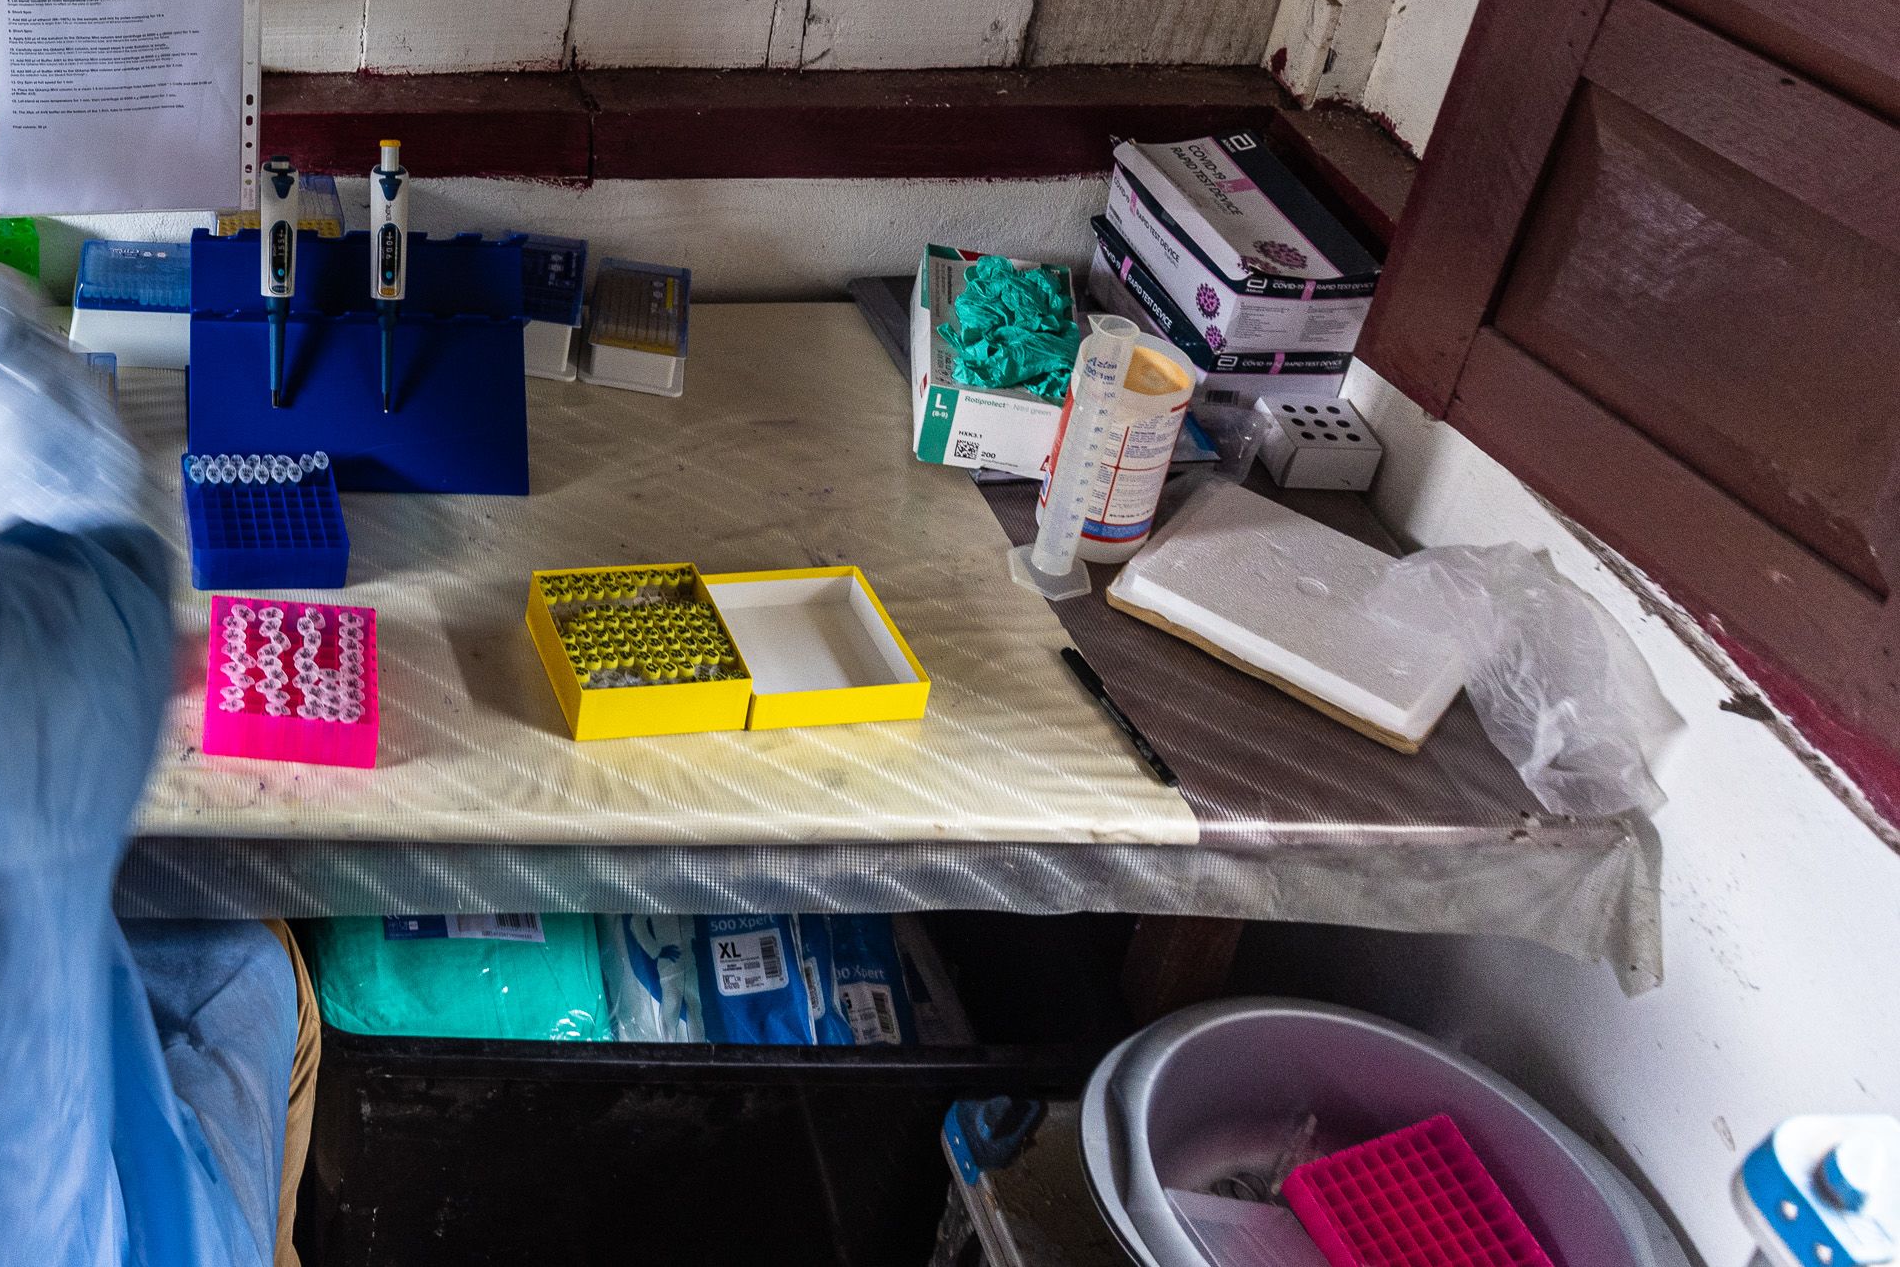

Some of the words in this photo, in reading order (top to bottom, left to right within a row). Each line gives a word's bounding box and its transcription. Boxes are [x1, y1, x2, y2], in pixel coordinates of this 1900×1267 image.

[1187, 144, 1227, 181] COVID-19
[1171, 145, 1193, 175] RAPID
[1189, 169, 1212, 194] TEST
[1209, 184, 1244, 217] DEVICE
[1127, 274, 1143, 296] RAPID
[1142, 291, 1154, 311] TEST
[1152, 303, 1173, 328] DEVICE
[935, 394, 947, 409] L
[711, 919, 736, 932] 500
[718, 942, 741, 959] XL
